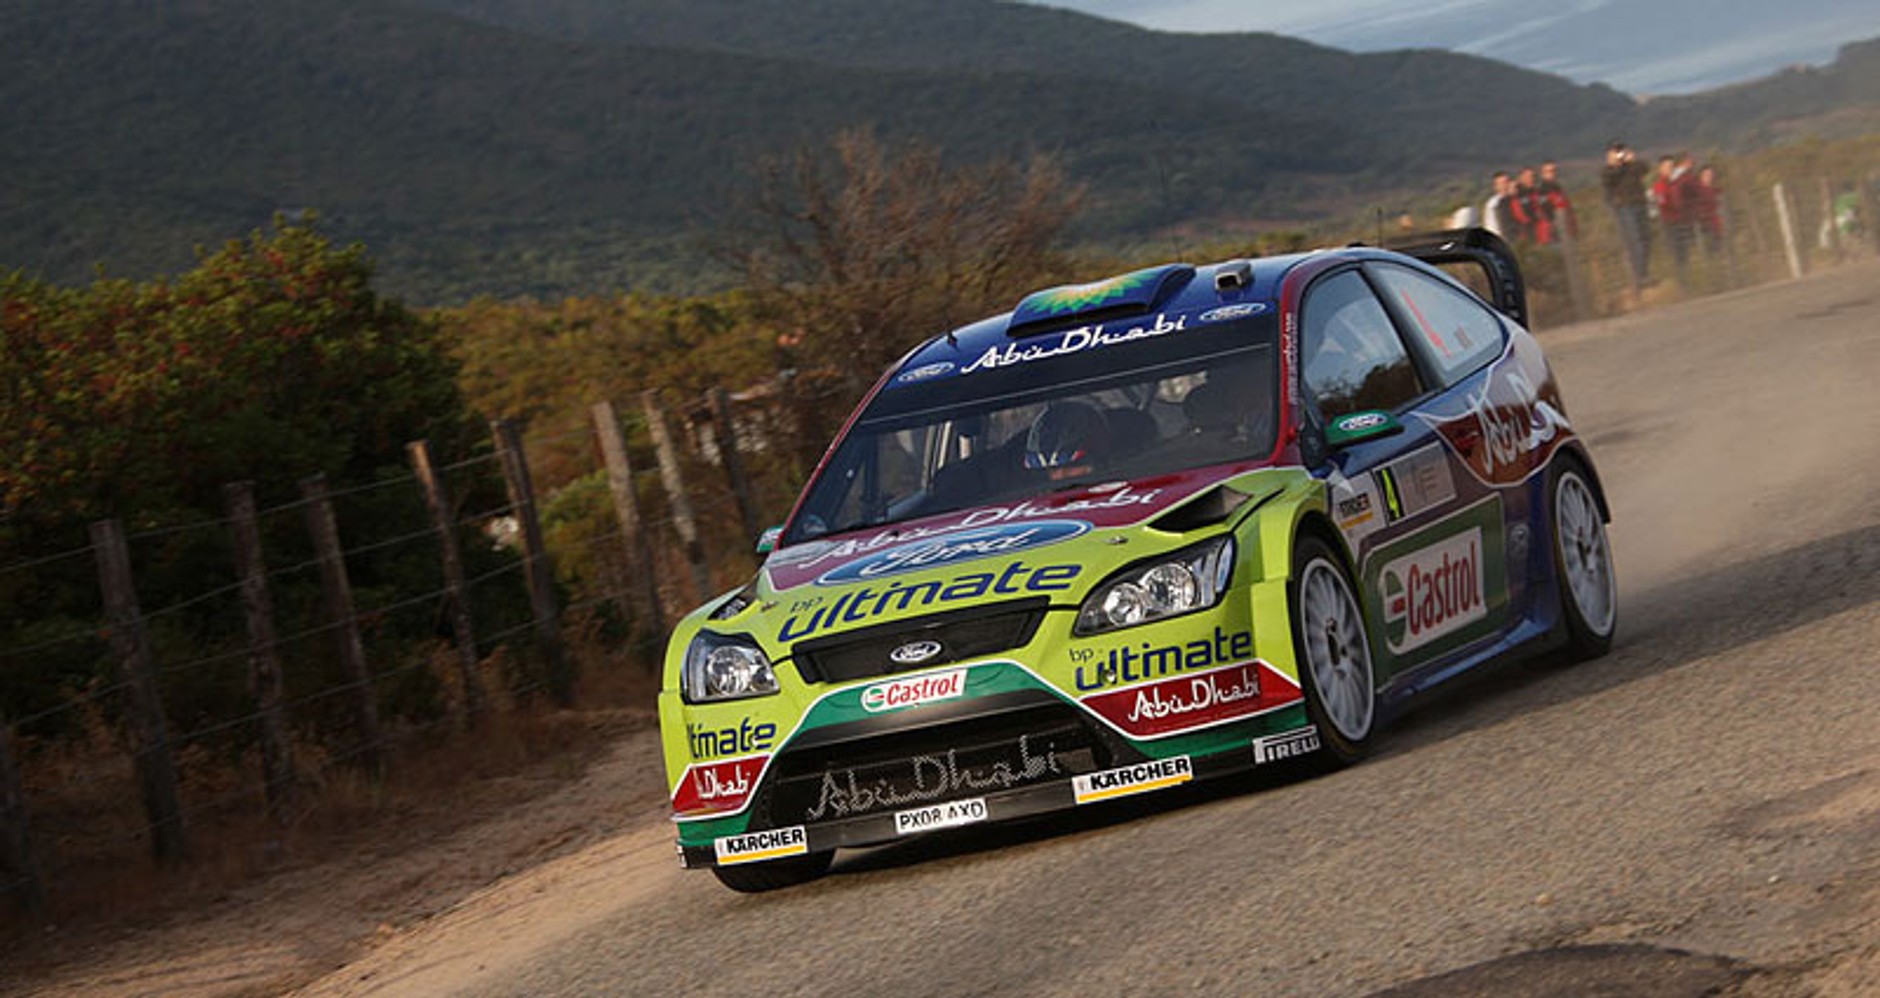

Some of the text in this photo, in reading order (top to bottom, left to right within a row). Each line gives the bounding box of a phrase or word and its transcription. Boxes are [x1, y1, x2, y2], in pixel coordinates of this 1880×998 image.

[860, 527, 1042, 576] Ford
[778, 561, 1082, 642] ultimate
[1407, 541, 1480, 635] Castrol
[1069, 648, 1094, 663] bp
[1075, 626, 1251, 691] ultimate
[887, 674, 958, 706] Castrol
